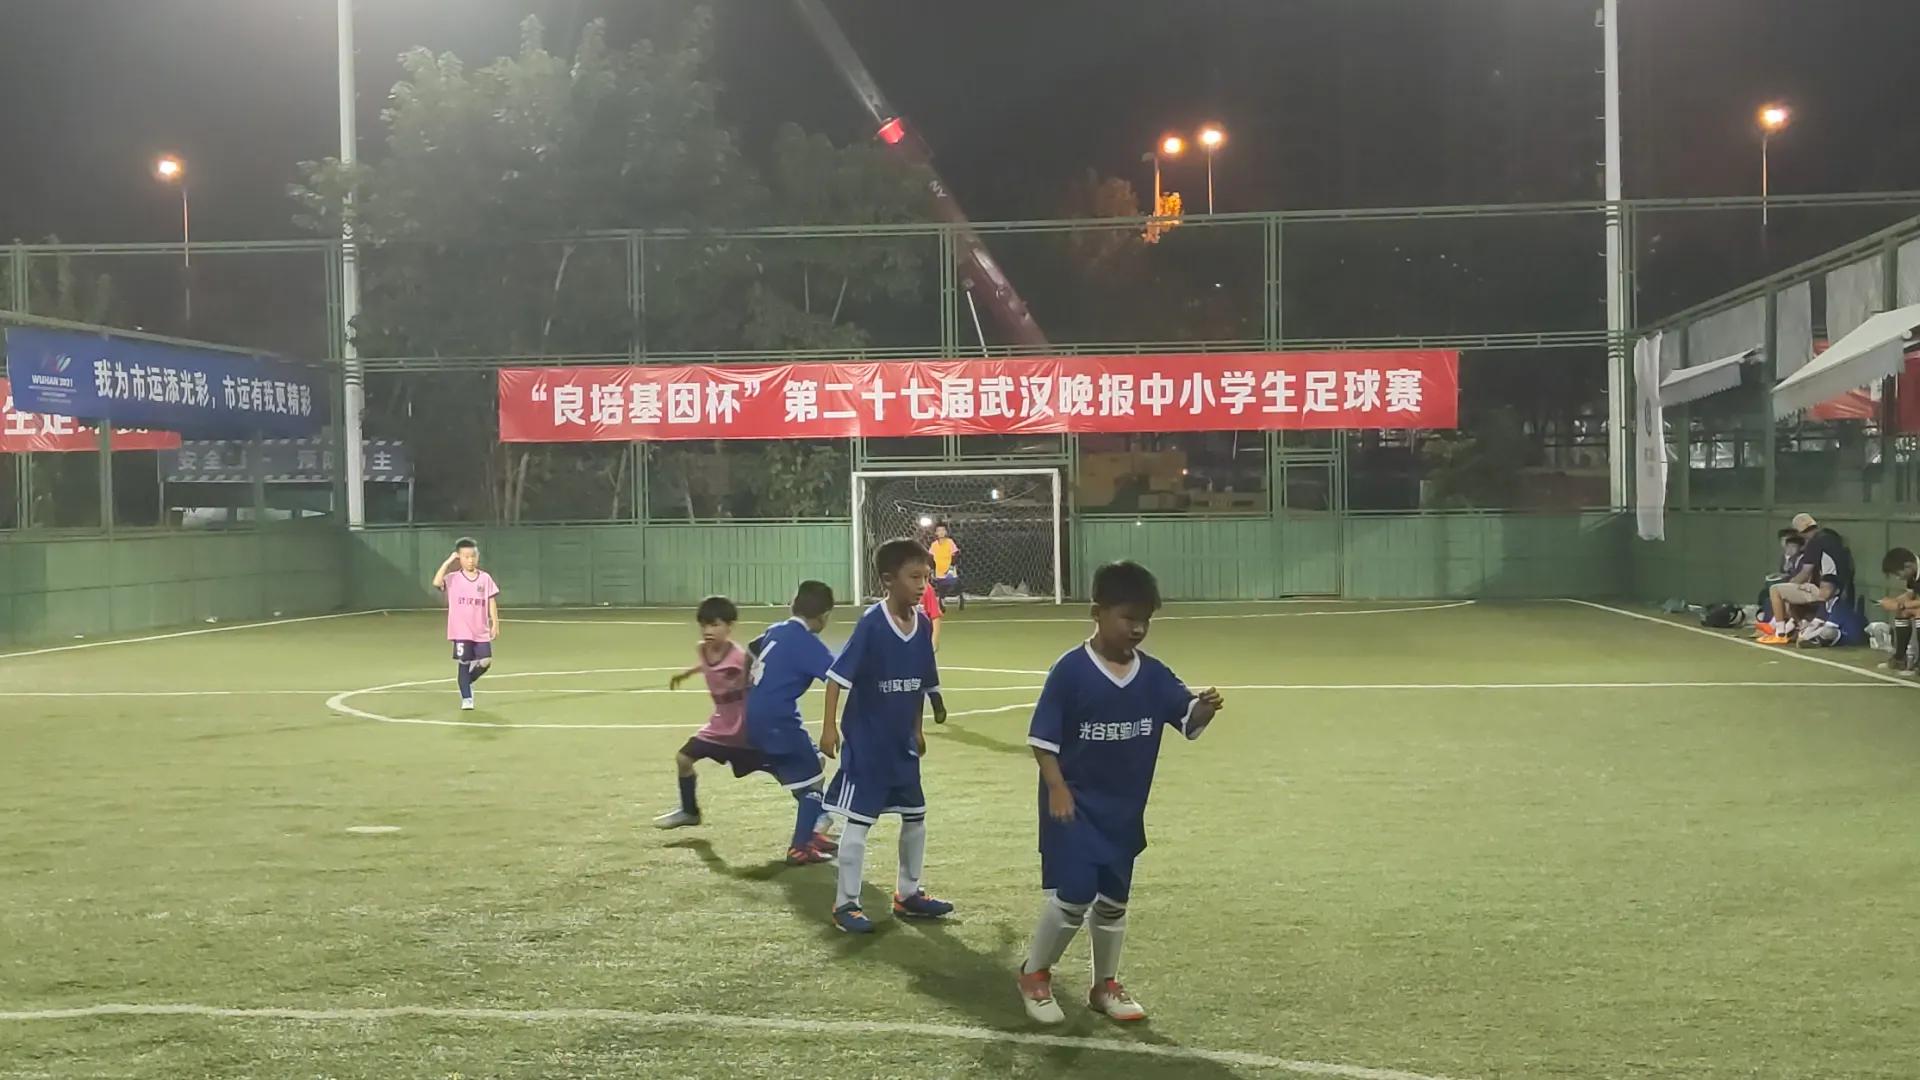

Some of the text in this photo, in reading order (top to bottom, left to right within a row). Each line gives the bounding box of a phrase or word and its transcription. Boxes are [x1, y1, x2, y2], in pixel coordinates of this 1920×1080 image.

[531, 367, 1424, 426] “良培基因杯” 第二十七届武汉晚报中小学生足球赛
[455, 642, 465, 657] 5
[1079, 717, 1153, 741] 光谷实验小学
